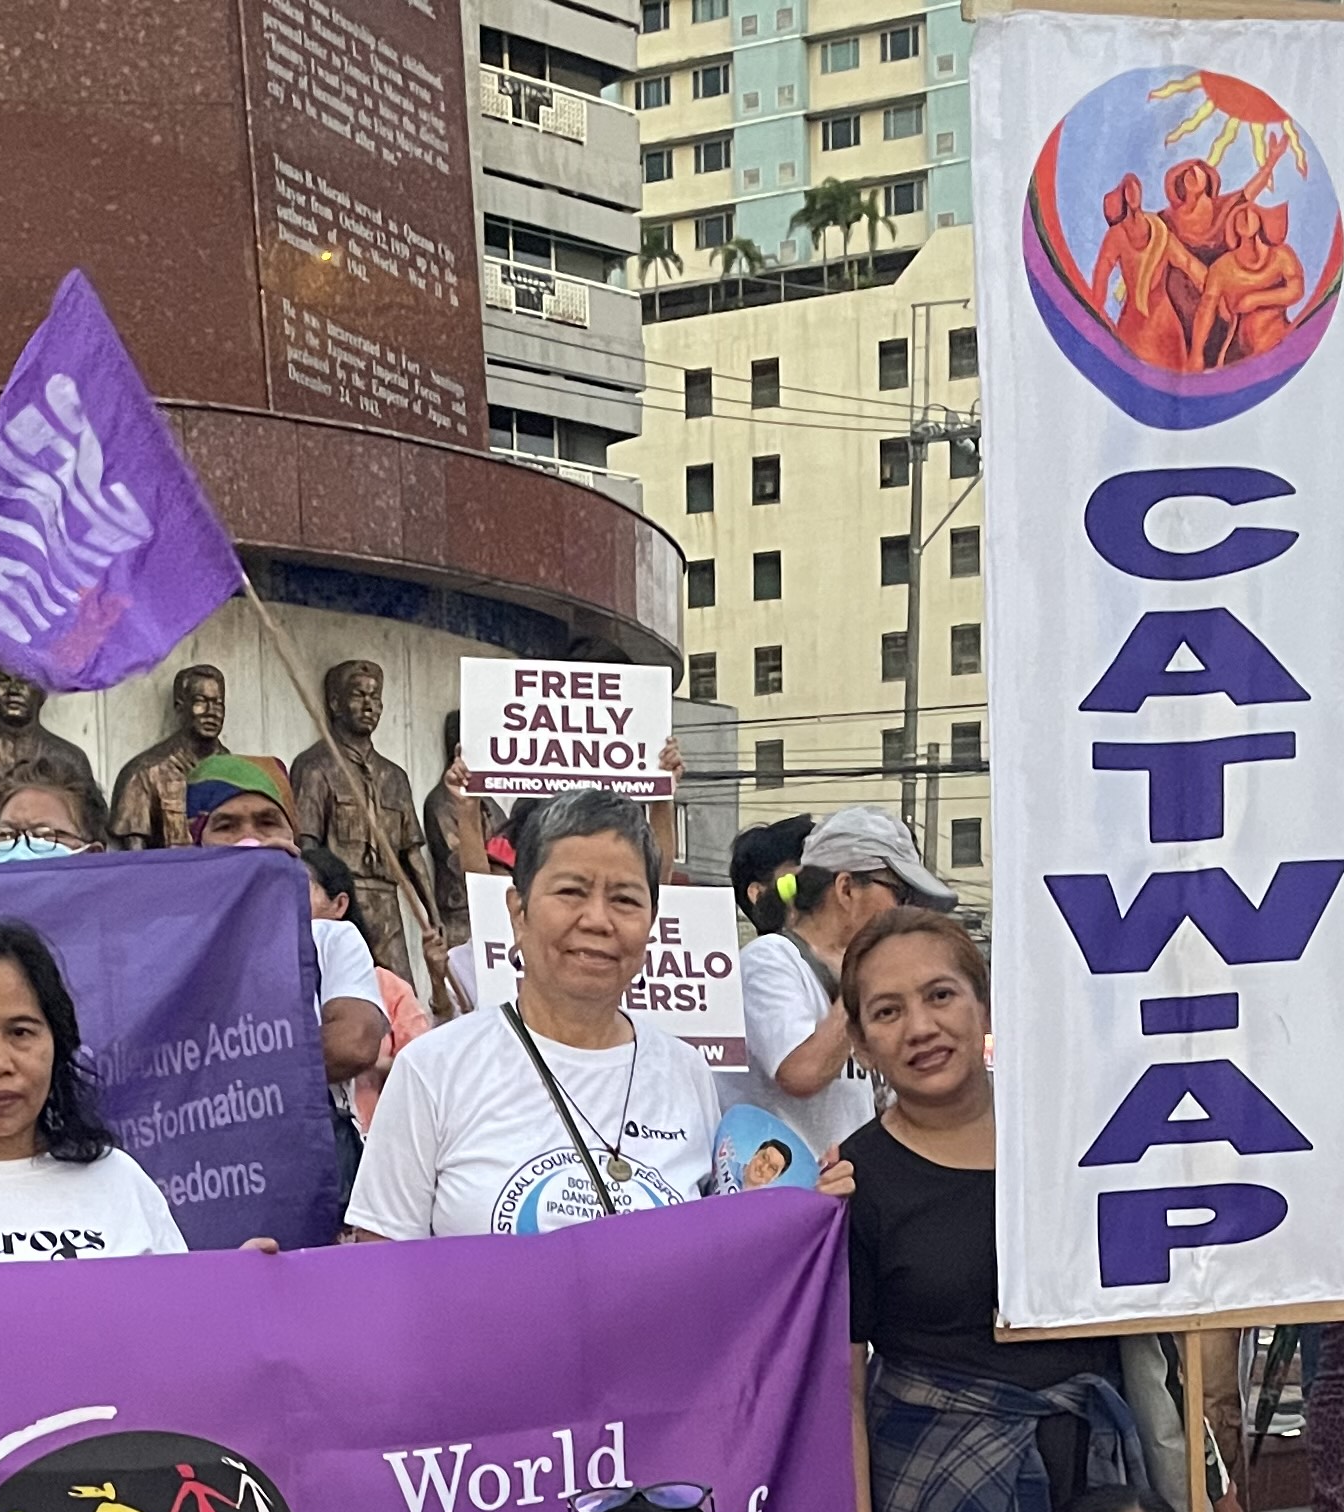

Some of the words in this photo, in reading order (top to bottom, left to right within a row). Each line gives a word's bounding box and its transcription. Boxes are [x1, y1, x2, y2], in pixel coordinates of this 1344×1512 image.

[515, 669, 622, 700] FREE
[503, 703, 634, 735] SALLY
[490, 736, 647, 770] UJANO!
[484, 776, 542, 791] SENTRO
[544, 779, 603, 791] WOMEN
[611, 781, 655, 793] WMW
[205, 1012, 294, 1066] Action
[116, 1078, 285, 1150] nsformation
[641, 1125, 688, 1142] Smart
[158, 1160, 267, 1206] edoms
[497, 1174, 535, 1235] STORAL
[531, 1151, 583, 1176] COUNC
[634, 1167, 685, 1206] RESPO
[561, 1189, 603, 1206] DANGA
